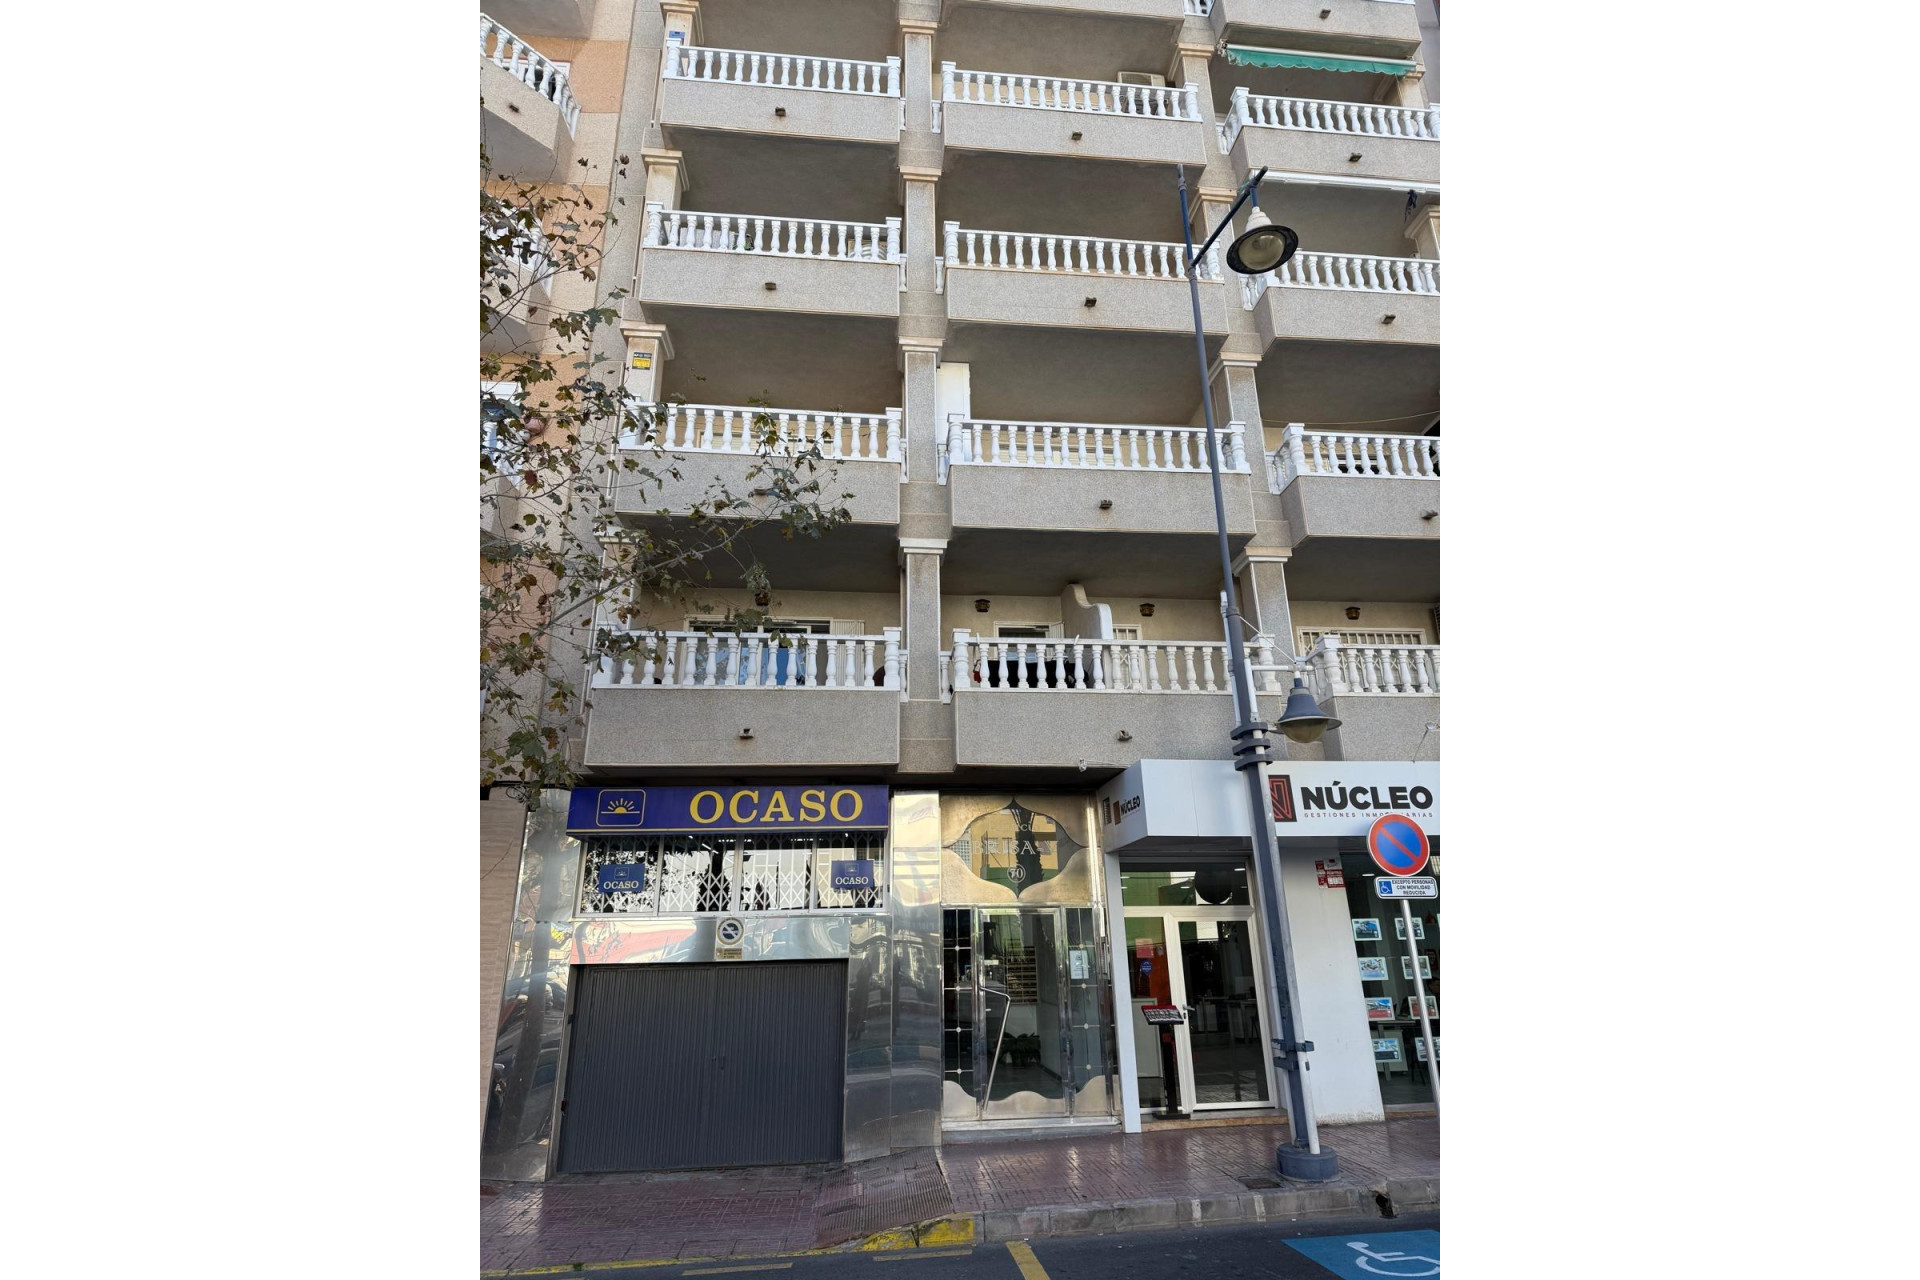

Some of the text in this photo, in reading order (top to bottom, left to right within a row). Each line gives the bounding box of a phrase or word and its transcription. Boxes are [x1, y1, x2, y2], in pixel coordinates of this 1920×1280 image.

[1120, 795, 1141, 815] NÚCLEO
[1300, 780, 1433, 810] NÚCLEO
[689, 789, 863, 824] OCASO
[603, 880, 639, 890] OCASO
[835, 876, 869, 885] OCASO
